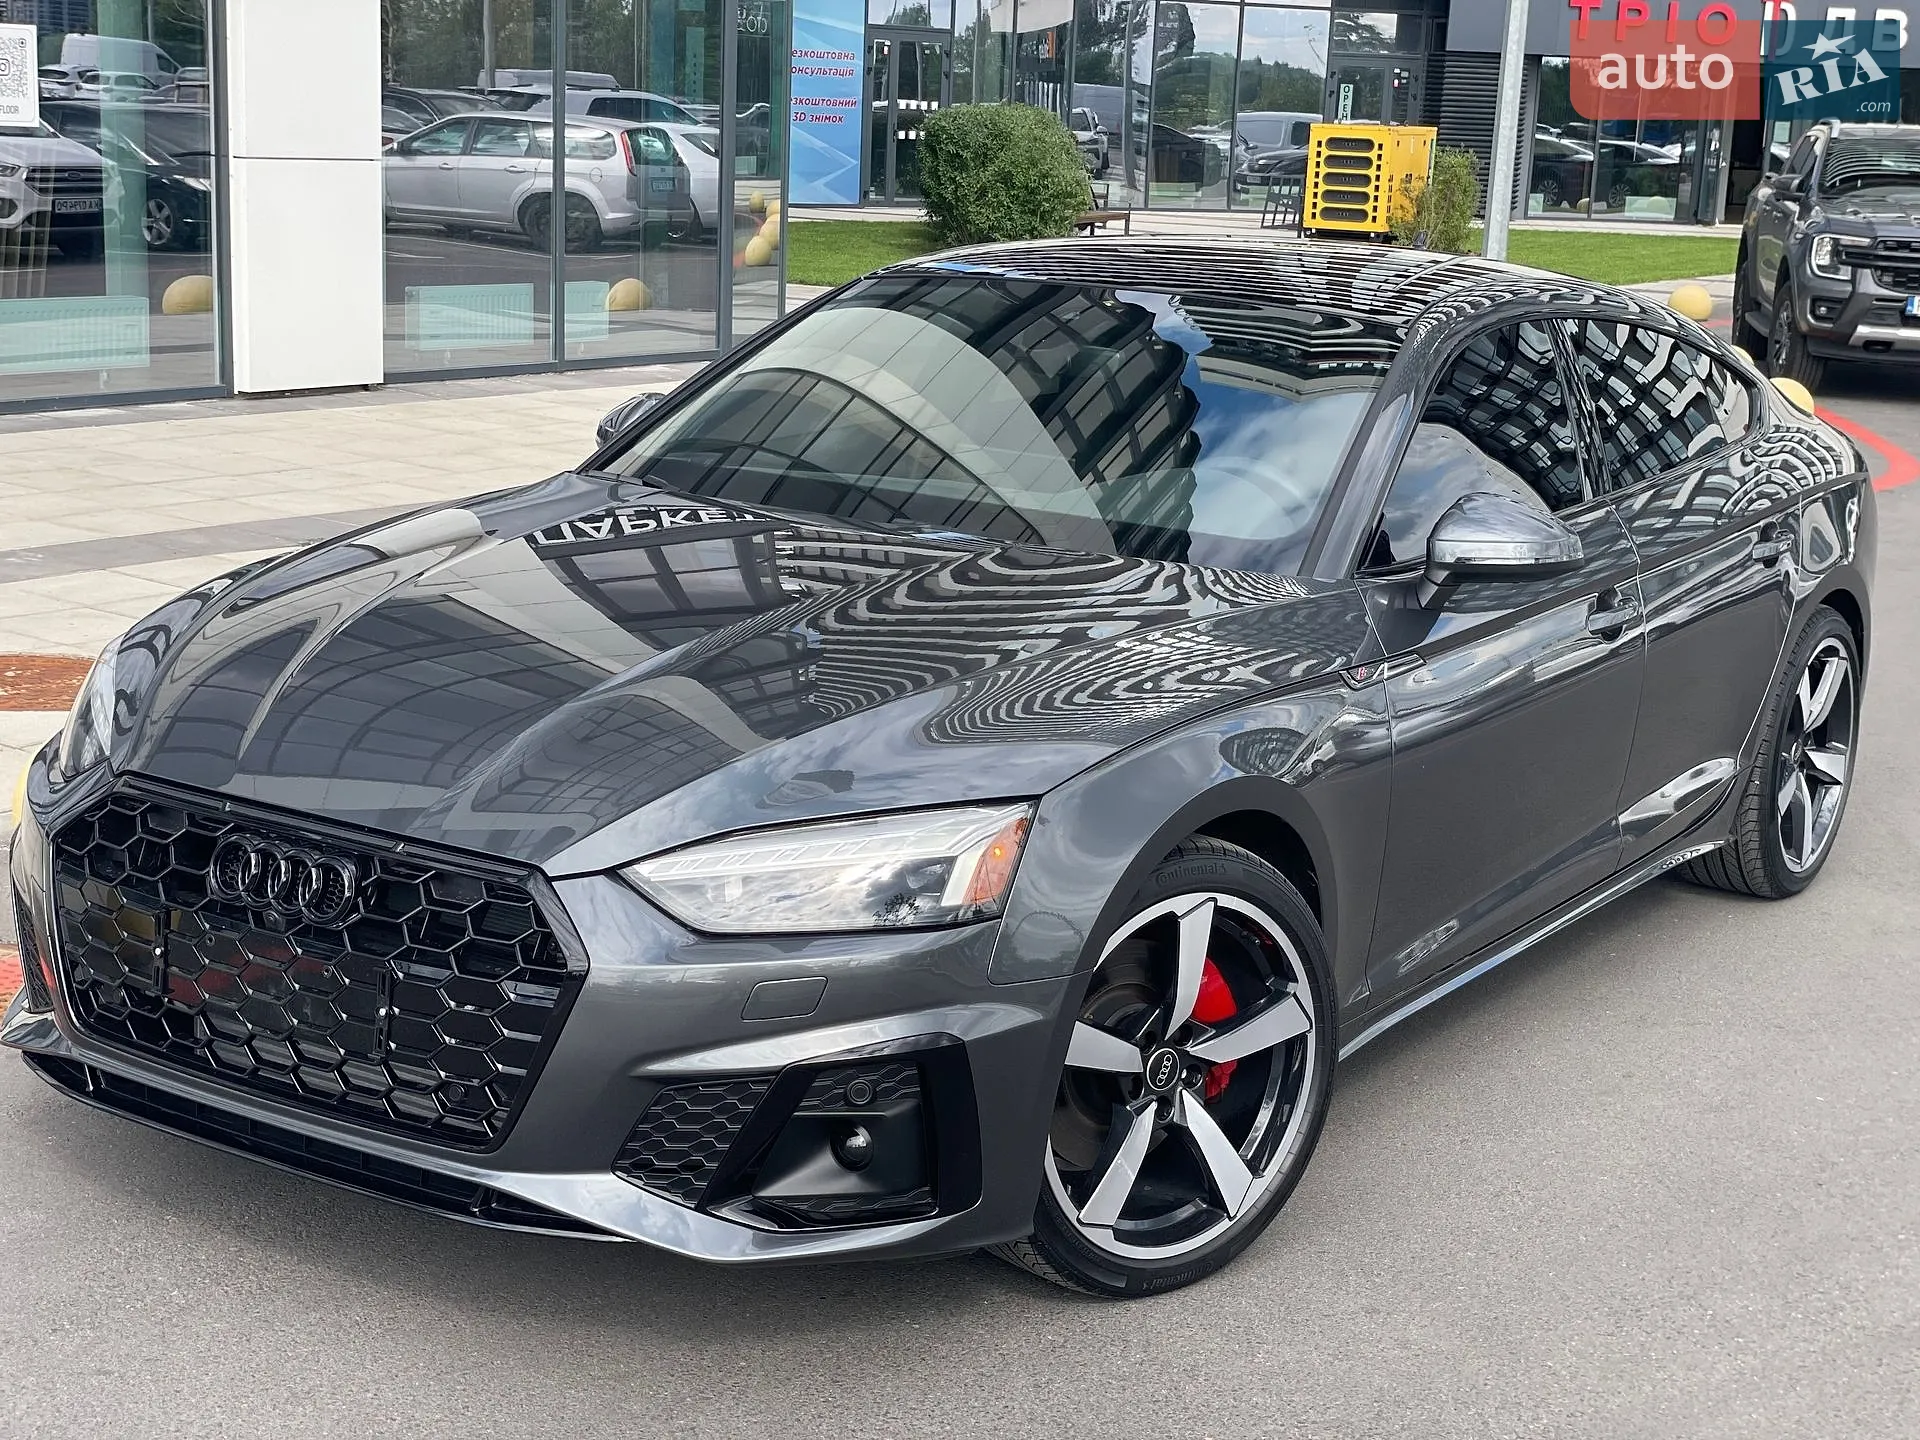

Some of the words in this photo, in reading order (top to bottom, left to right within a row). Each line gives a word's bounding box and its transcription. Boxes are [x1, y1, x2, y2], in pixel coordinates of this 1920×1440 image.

[791, 97, 857, 108] зкоштовний
[793, 111, 807, 122] 3D
[809, 112, 844, 124] знімок
